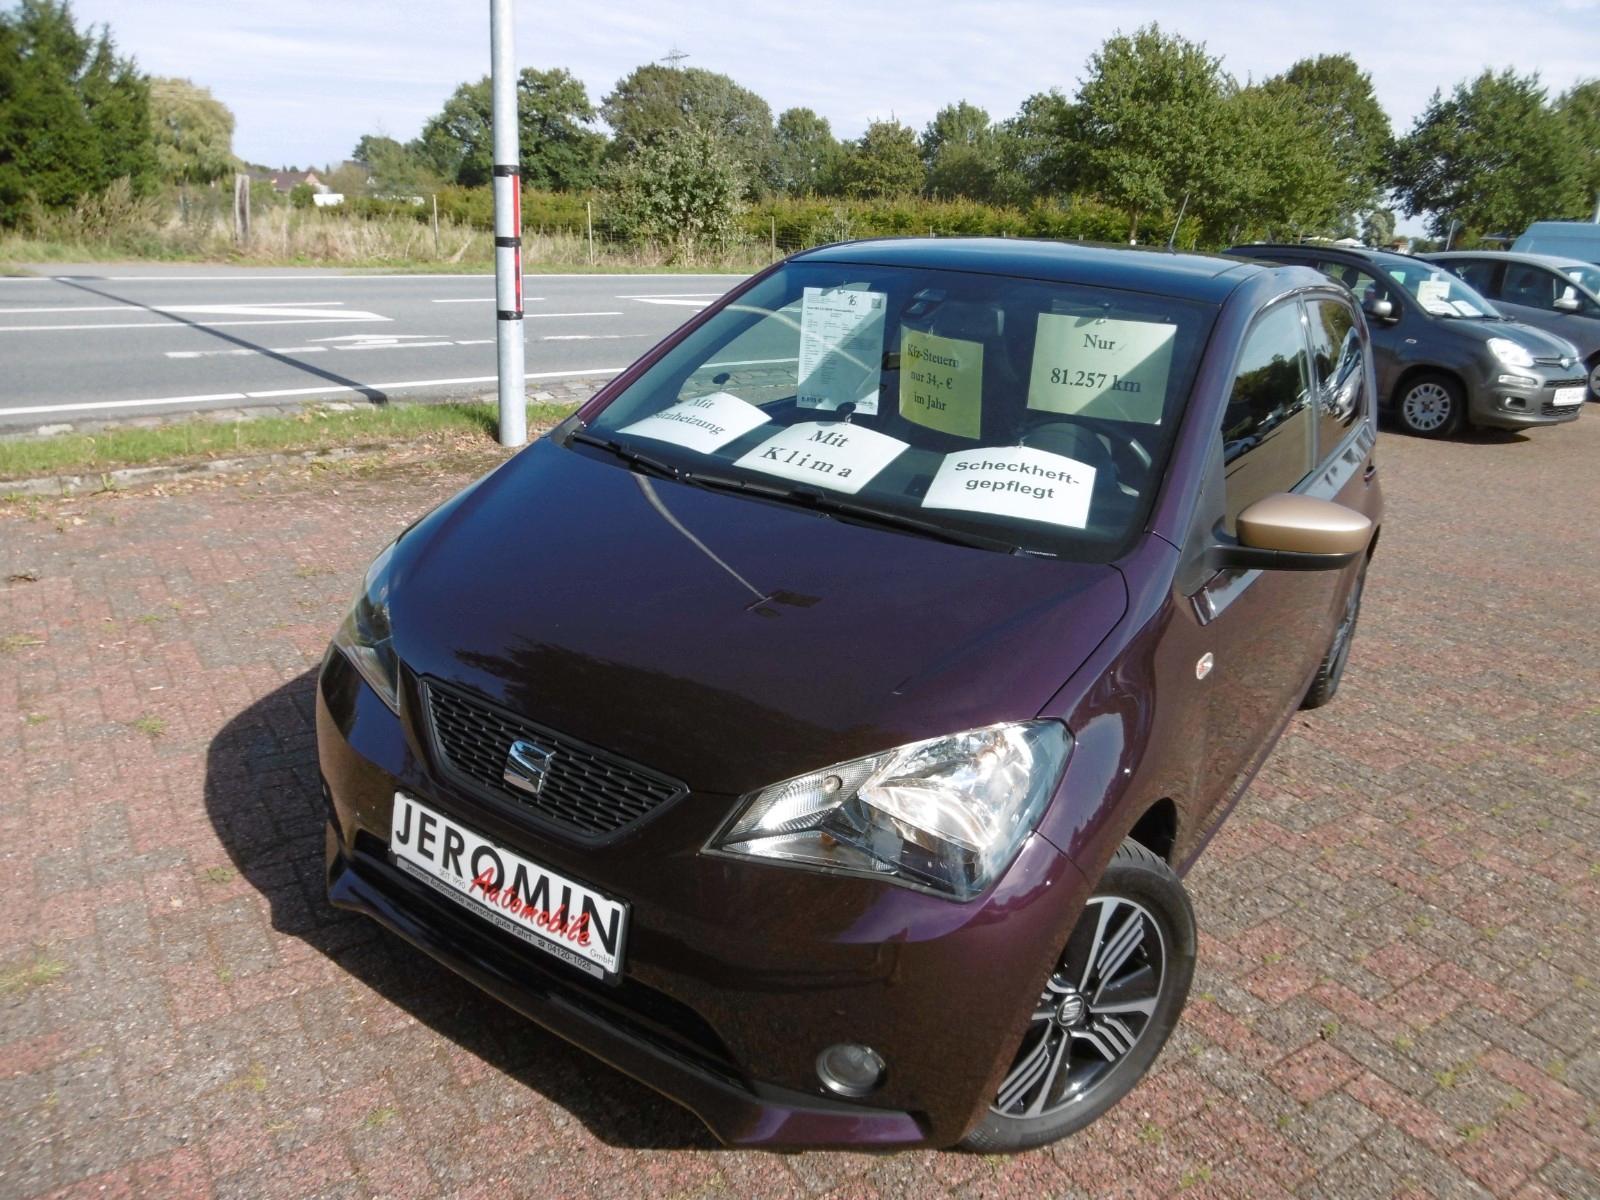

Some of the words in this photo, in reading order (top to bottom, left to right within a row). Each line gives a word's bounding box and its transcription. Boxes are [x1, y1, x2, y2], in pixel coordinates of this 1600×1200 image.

[1083, 333, 1116, 351] Nur
[907, 343, 960, 368] Kfz-Steuern
[911, 370, 924, 383] nur
[946, 377, 953, 390] €
[1050, 367, 1106, 390] 81.257
[1111, 375, 1141, 393] km
[689, 398, 716, 409] Mit
[914, 391, 925, 405] im
[926, 394, 947, 411] Jahr
[808, 429, 849, 448] Mit
[761, 446, 853, 478] Klima
[954, 459, 1080, 485] Scheckheft-
[965, 477, 1055, 499] gepflegt
[395, 803, 620, 957] JEROMIN
[469, 866, 592, 947] Automobile
[495, 917, 511, 931] gute
[512, 923, 533, 941] Fahrt
[590, 948, 614, 966] GmbH
